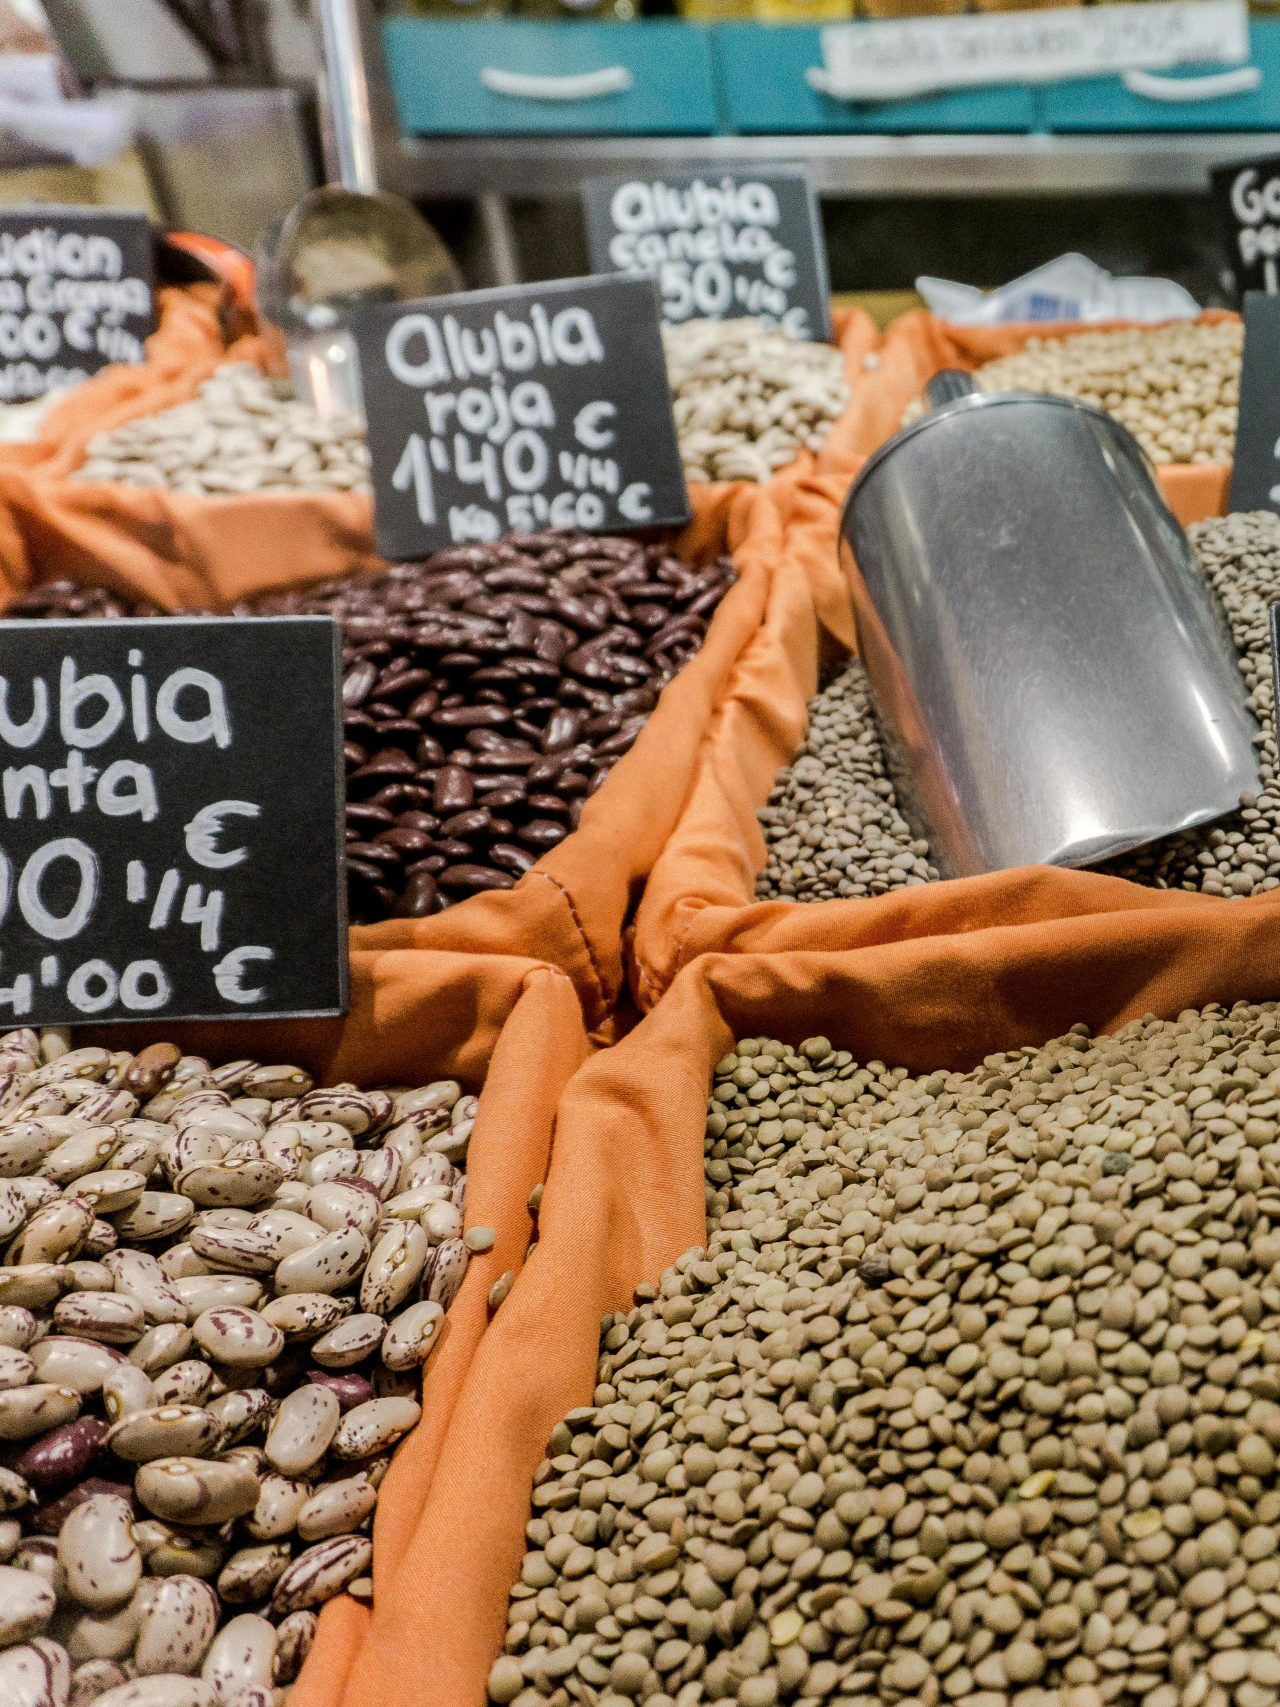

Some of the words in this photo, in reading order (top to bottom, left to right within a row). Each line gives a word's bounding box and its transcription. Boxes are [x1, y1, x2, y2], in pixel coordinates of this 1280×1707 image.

[424, 372, 556, 444] roja
[392, 429, 550, 526] 1'40
[559, 450, 621, 494] 1/4
[183, 800, 263, 869] €
[212, 945, 275, 1004] €
